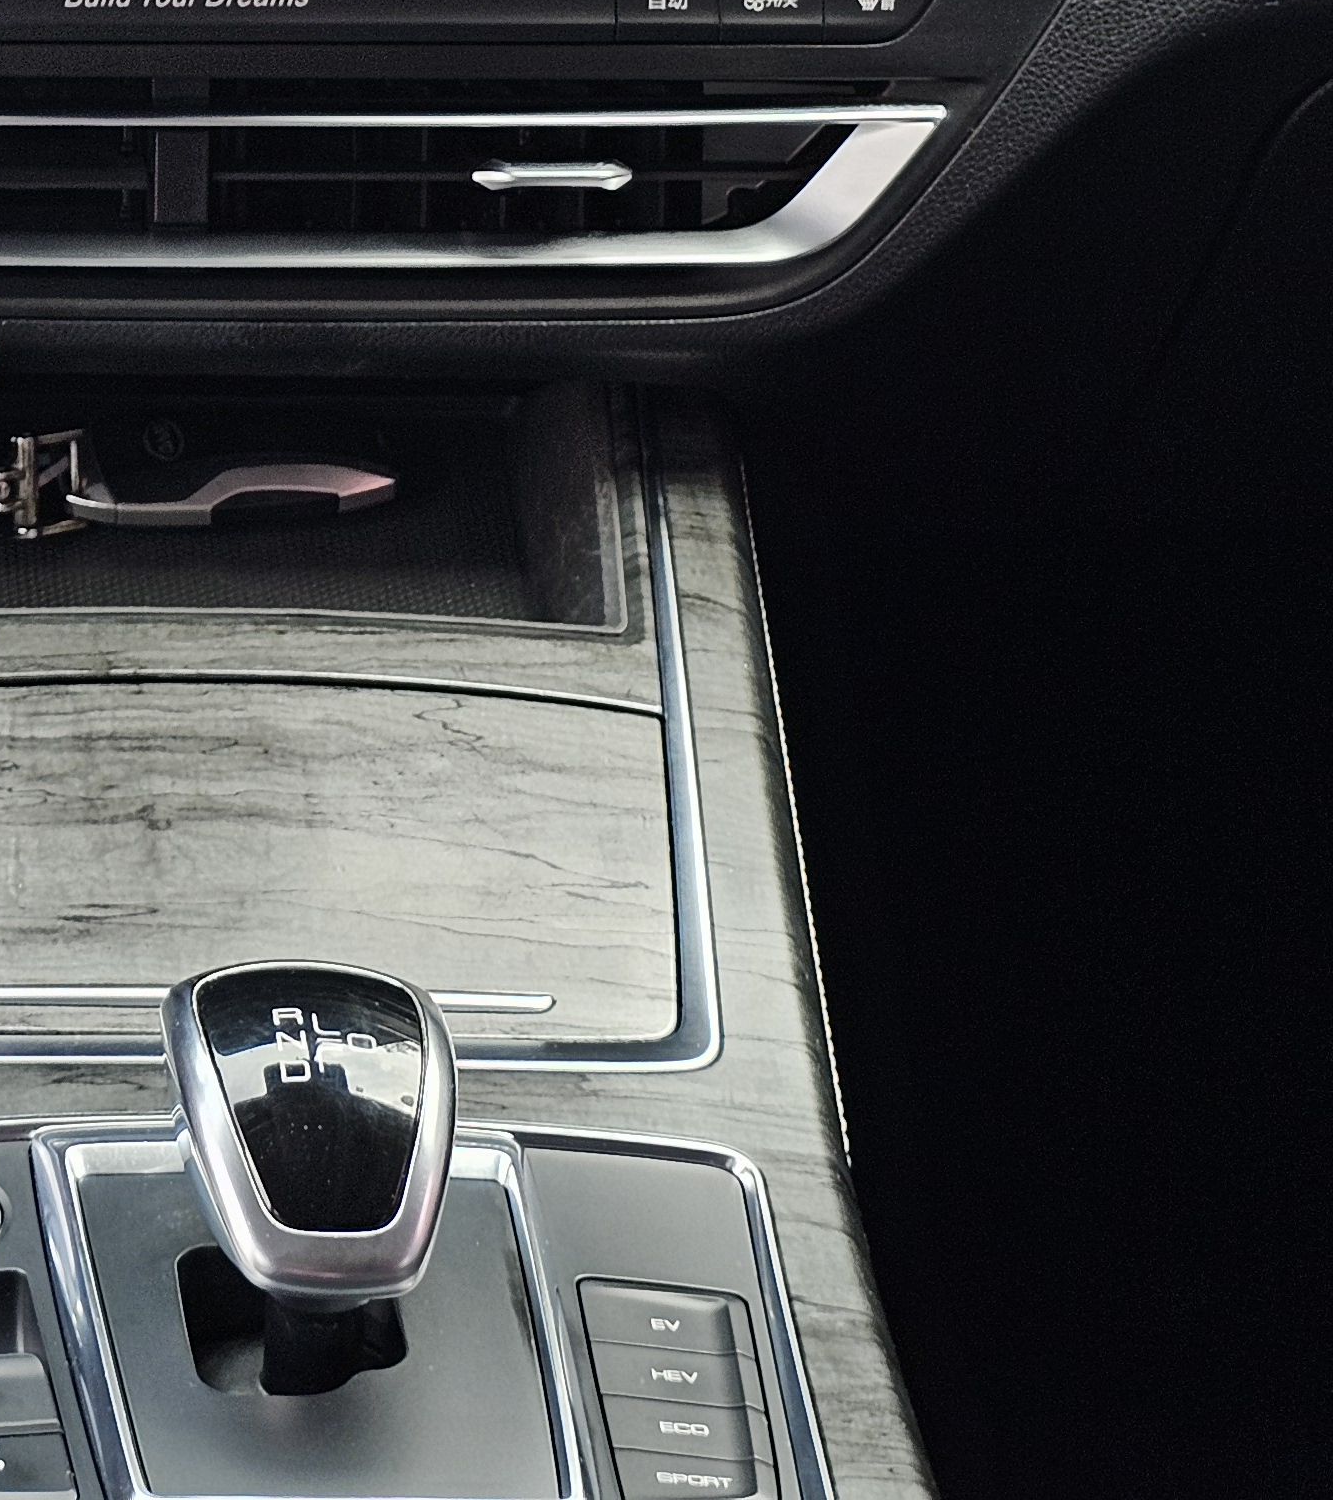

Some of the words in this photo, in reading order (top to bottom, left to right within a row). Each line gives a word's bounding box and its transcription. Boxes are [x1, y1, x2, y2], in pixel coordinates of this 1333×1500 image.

[271, 1007, 305, 1027] R
[275, 1029, 311, 1061] N
[279, 1060, 312, 1084] D
[650, 1317, 681, 1333] EV
[650, 1367, 699, 1385] HEV
[658, 1420, 711, 1438] ECO
[655, 1471, 734, 1491] SPORT
